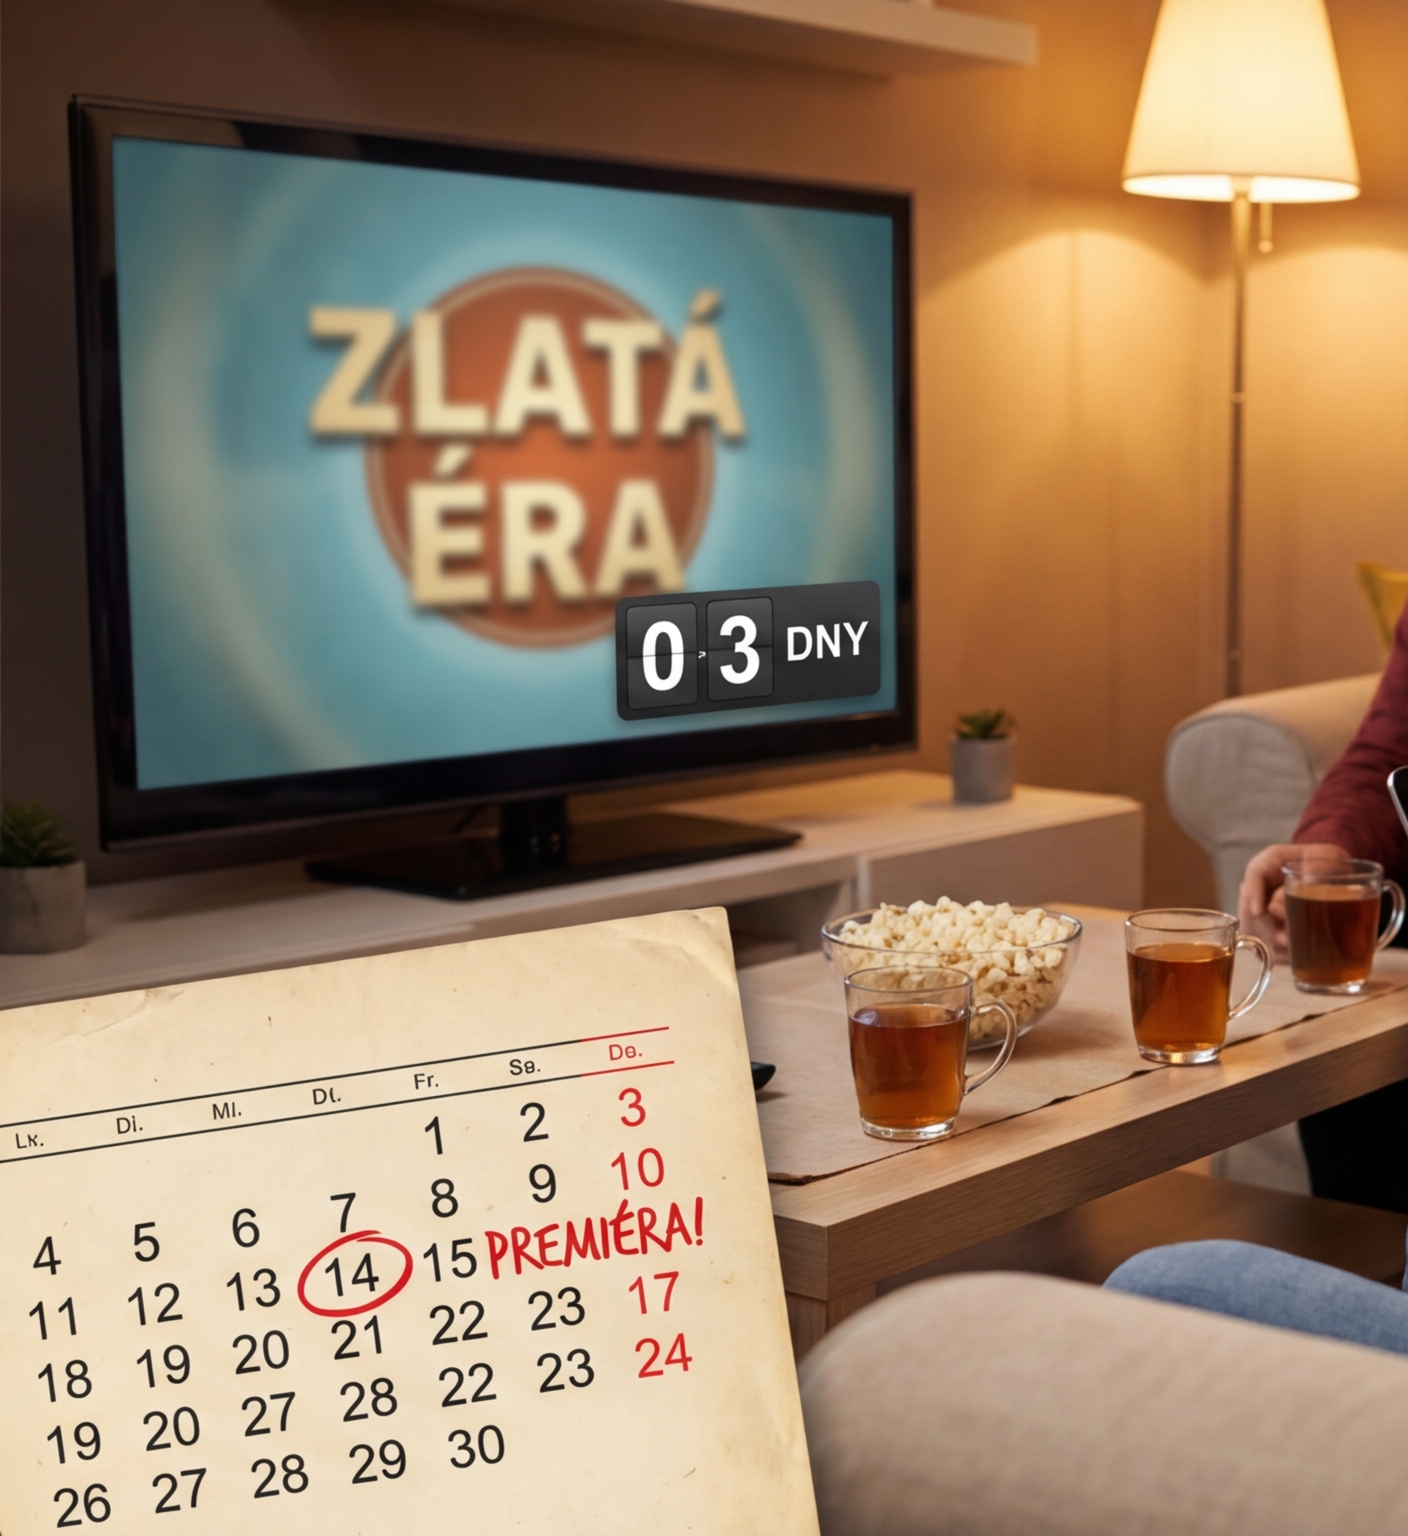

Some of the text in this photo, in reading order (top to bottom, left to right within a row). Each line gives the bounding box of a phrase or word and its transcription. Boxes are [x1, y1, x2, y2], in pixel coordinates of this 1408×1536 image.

[309, 288, 746, 438] ZLATÁ
[407, 444, 687, 606] ÉRA
[786, 620, 869, 662] DNY
[413, 1072, 440, 1090] Fr.
[424, 1086, 647, 1155] 1 2 3
[32, 1146, 666, 1276] 4 5 6 7 8 9 10
[484, 1196, 704, 1280] PREMIÉRA!
[28, 1237, 478, 1341] 11 12 13 14 15
[36, 1270, 681, 1403] 18 19 20 21 22 23 17
[46, 1332, 694, 1465] 19 20 27 28 22 23 24
[52, 1424, 506, 1529] 26 27 28 29 30
